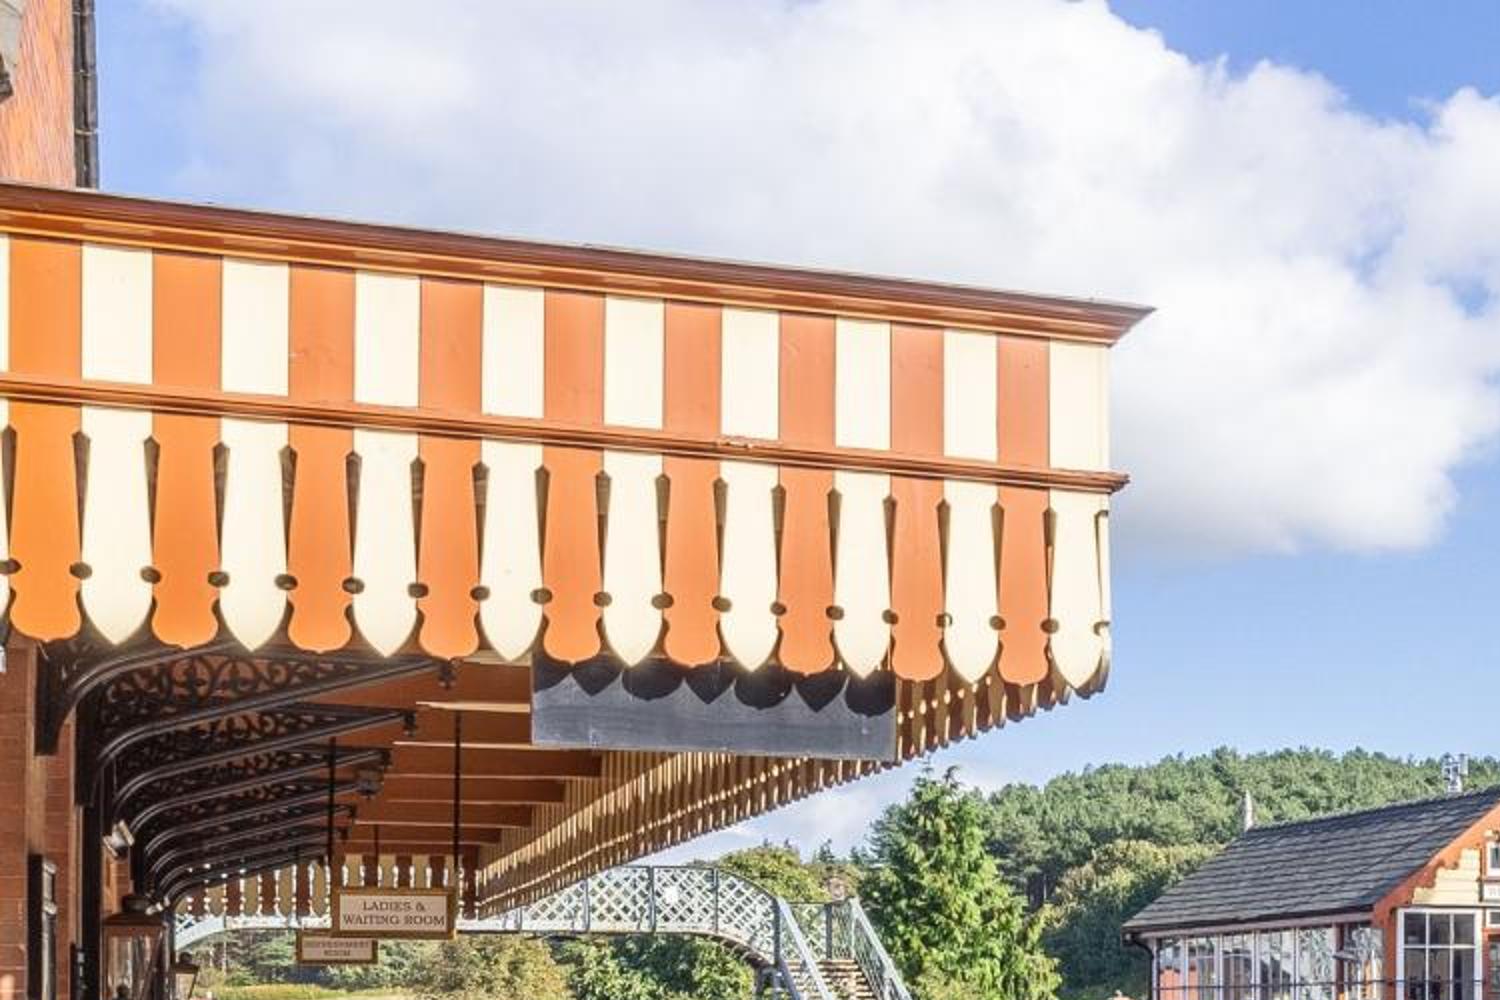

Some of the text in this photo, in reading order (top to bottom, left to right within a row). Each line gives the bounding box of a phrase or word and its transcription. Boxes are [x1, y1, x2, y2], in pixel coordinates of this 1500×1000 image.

[363, 901, 426, 912] LADIES &
[343, 914, 445, 926] WAITING ROOM
